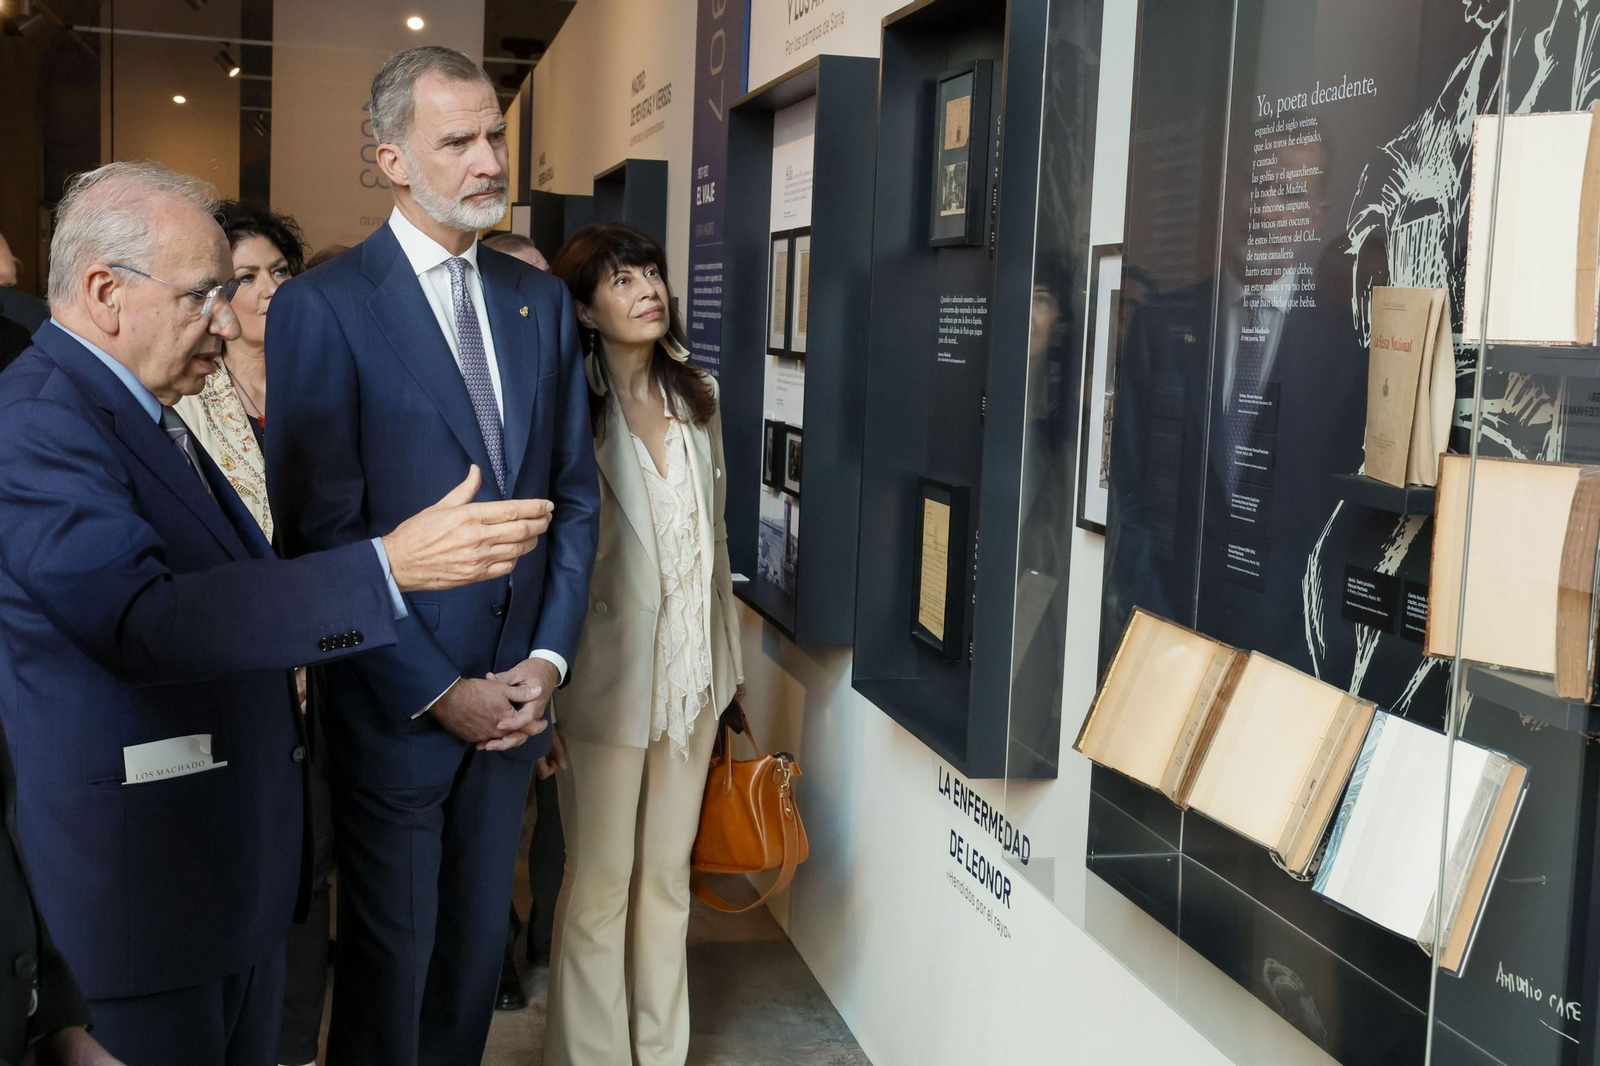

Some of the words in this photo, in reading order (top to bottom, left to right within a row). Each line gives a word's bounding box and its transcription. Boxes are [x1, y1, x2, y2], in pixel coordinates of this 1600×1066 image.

[802, 24, 821, 46] campos
[823, 18, 829, 35] de
[830, 9, 844, 30] Soria
[1257, 94, 1272, 118] Yo,
[1276, 92, 1308, 118] poeta
[1311, 74, 1377, 105] decadente,
[1254, 122, 1275, 138] español
[1276, 120, 1284, 132] del
[1285, 118, 1298, 132] siglo
[1299, 116, 1318, 127] veinte,
[1254, 144, 1263, 154] que
[1273, 140, 1287, 149] toros
[1288, 134, 1295, 146] he
[1296, 130, 1322, 146] elogiado,
[1252, 160, 1256, 170] y
[1257, 153, 1278, 167] cantado
[1259, 170, 1275, 184] golfas
[1276, 173, 1280, 182] y
[1280, 168, 1285, 179] el
[1286, 164, 1324, 180] aguardiente...
[696, 186, 702, 206] EL
[702, 182, 715, 204] VIAJE
[1250, 192, 1254, 202] y
[1254, 187, 1260, 198] la
[1260, 186, 1276, 197] noche
[1278, 184, 1285, 196] de
[1286, 181, 1308, 194] Madrid,
[1250, 207, 1253, 217] y
[1262, 203, 1285, 213] rincones
[1286, 200, 1310, 212] impuros,
[1248, 222, 1252, 232] y
[1261, 219, 1276, 229] vicios
[1276, 217, 1288, 228] más
[1288, 218, 1310, 227] oscuros
[1247, 234, 1254, 245] de
[1254, 237, 1268, 245] estos
[1293, 230, 1302, 242] del
[1246, 250, 1254, 261] de
[1254, 252, 1268, 261] tanta
[1245, 266, 1260, 276] harto
[1282, 266, 1296, 278] poco
[1244, 284, 1250, 294] ya
[1251, 284, 1264, 294] estoy
[1280, 284, 1284, 293] y
[1284, 284, 1291, 294] ya
[1292, 283, 1300, 291] no
[1301, 280, 1316, 291] bebo
[1243, 296, 1249, 307] lo
[1250, 300, 1259, 310] que
[1260, 296, 1270, 307] han
[1272, 296, 1287, 307] dicho
[1288, 300, 1298, 310] que
[1391, 337, 1413, 353] Nacional
[135, 770, 154, 781] LOS
[156, 760, 205, 777] MACHADO
[938, 766, 951, 800] LA
[953, 778, 1030, 866] ENFERMEDAD
[950, 829, 964, 865] DE
[965, 843, 1011, 910] LEONOR
[976, 898, 986, 916] por
[986, 909, 993, 924] el
